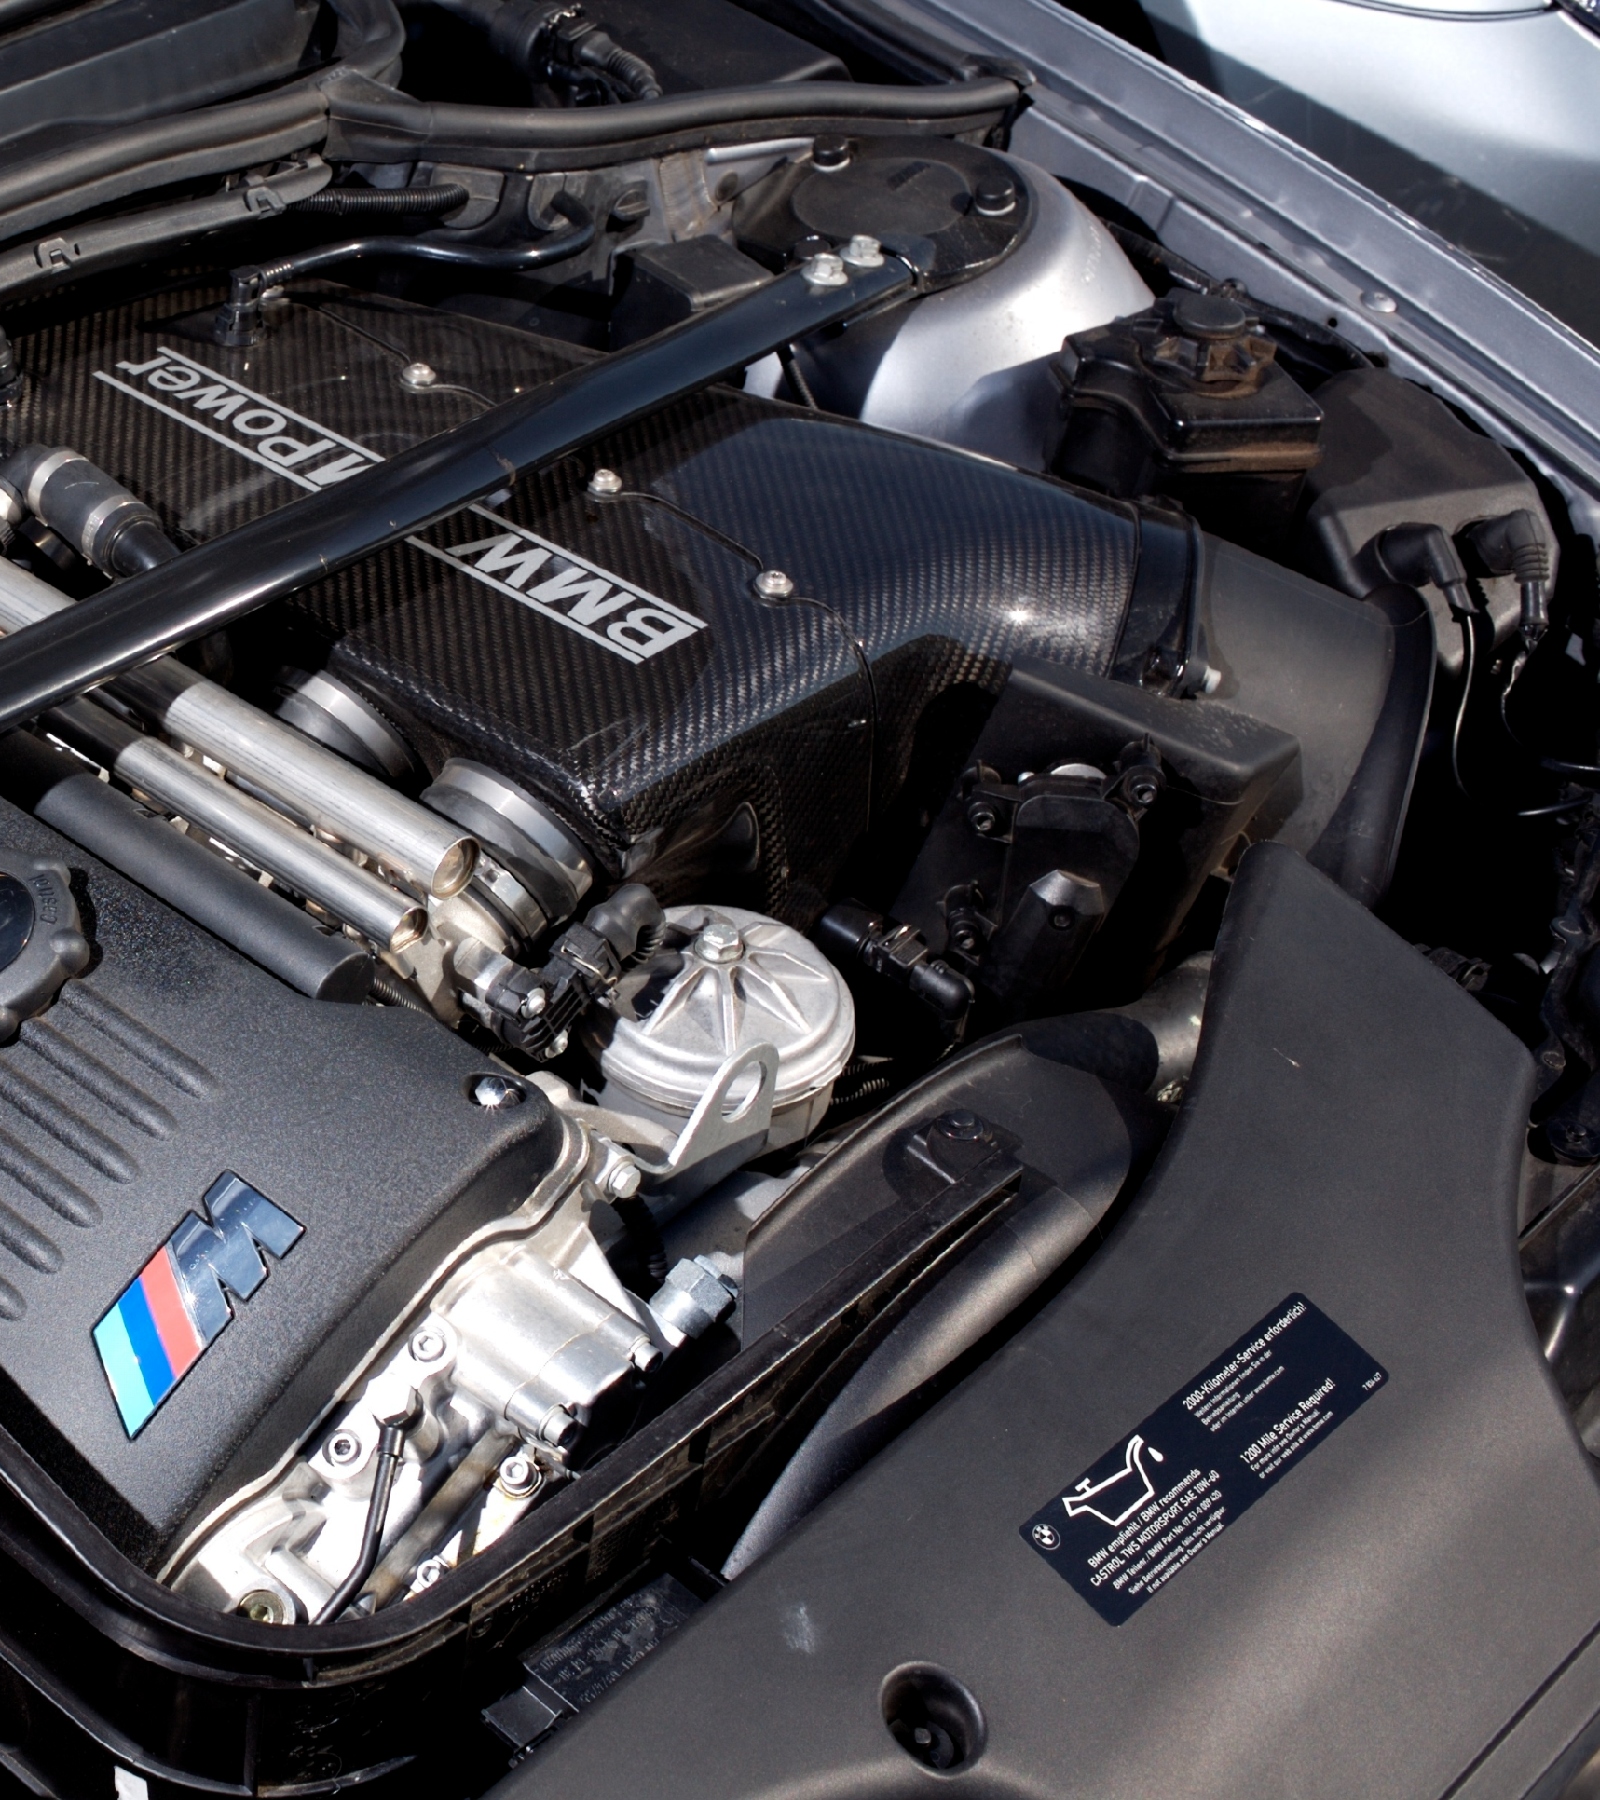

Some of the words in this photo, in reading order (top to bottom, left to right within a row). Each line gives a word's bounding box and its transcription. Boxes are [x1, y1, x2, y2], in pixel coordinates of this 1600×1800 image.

[446, 531, 697, 660] BMW
[29, 873, 58, 925] Castrol
[1182, 1338, 1266, 1411] 2000-Kilometer-Service
[1263, 1301, 1307, 1342] erforderlich!
[1239, 1442, 1262, 1467] 1200
[1256, 1431, 1279, 1449] Mile
[1272, 1408, 1304, 1436] Service
[1297, 1377, 1336, 1413] Required!
[1087, 1547, 1110, 1569] BMW
[1107, 1521, 1141, 1553] empfiehlt
[1139, 1501, 1161, 1523] BMW
[1158, 1468, 1201, 1507] recommends
[1089, 1555, 1126, 1587] CASTROL
[1119, 1540, 1141, 1559] TWS
[1136, 1501, 1184, 1546] MOTORSPORT
[1179, 1489, 1198, 1508] SAE
[1193, 1469, 1220, 1495] 10W-60
[1112, 1572, 1129, 1590] BMW
[1147, 1540, 1165, 1558] BMW
[1160, 1531, 1177, 1546] Part
